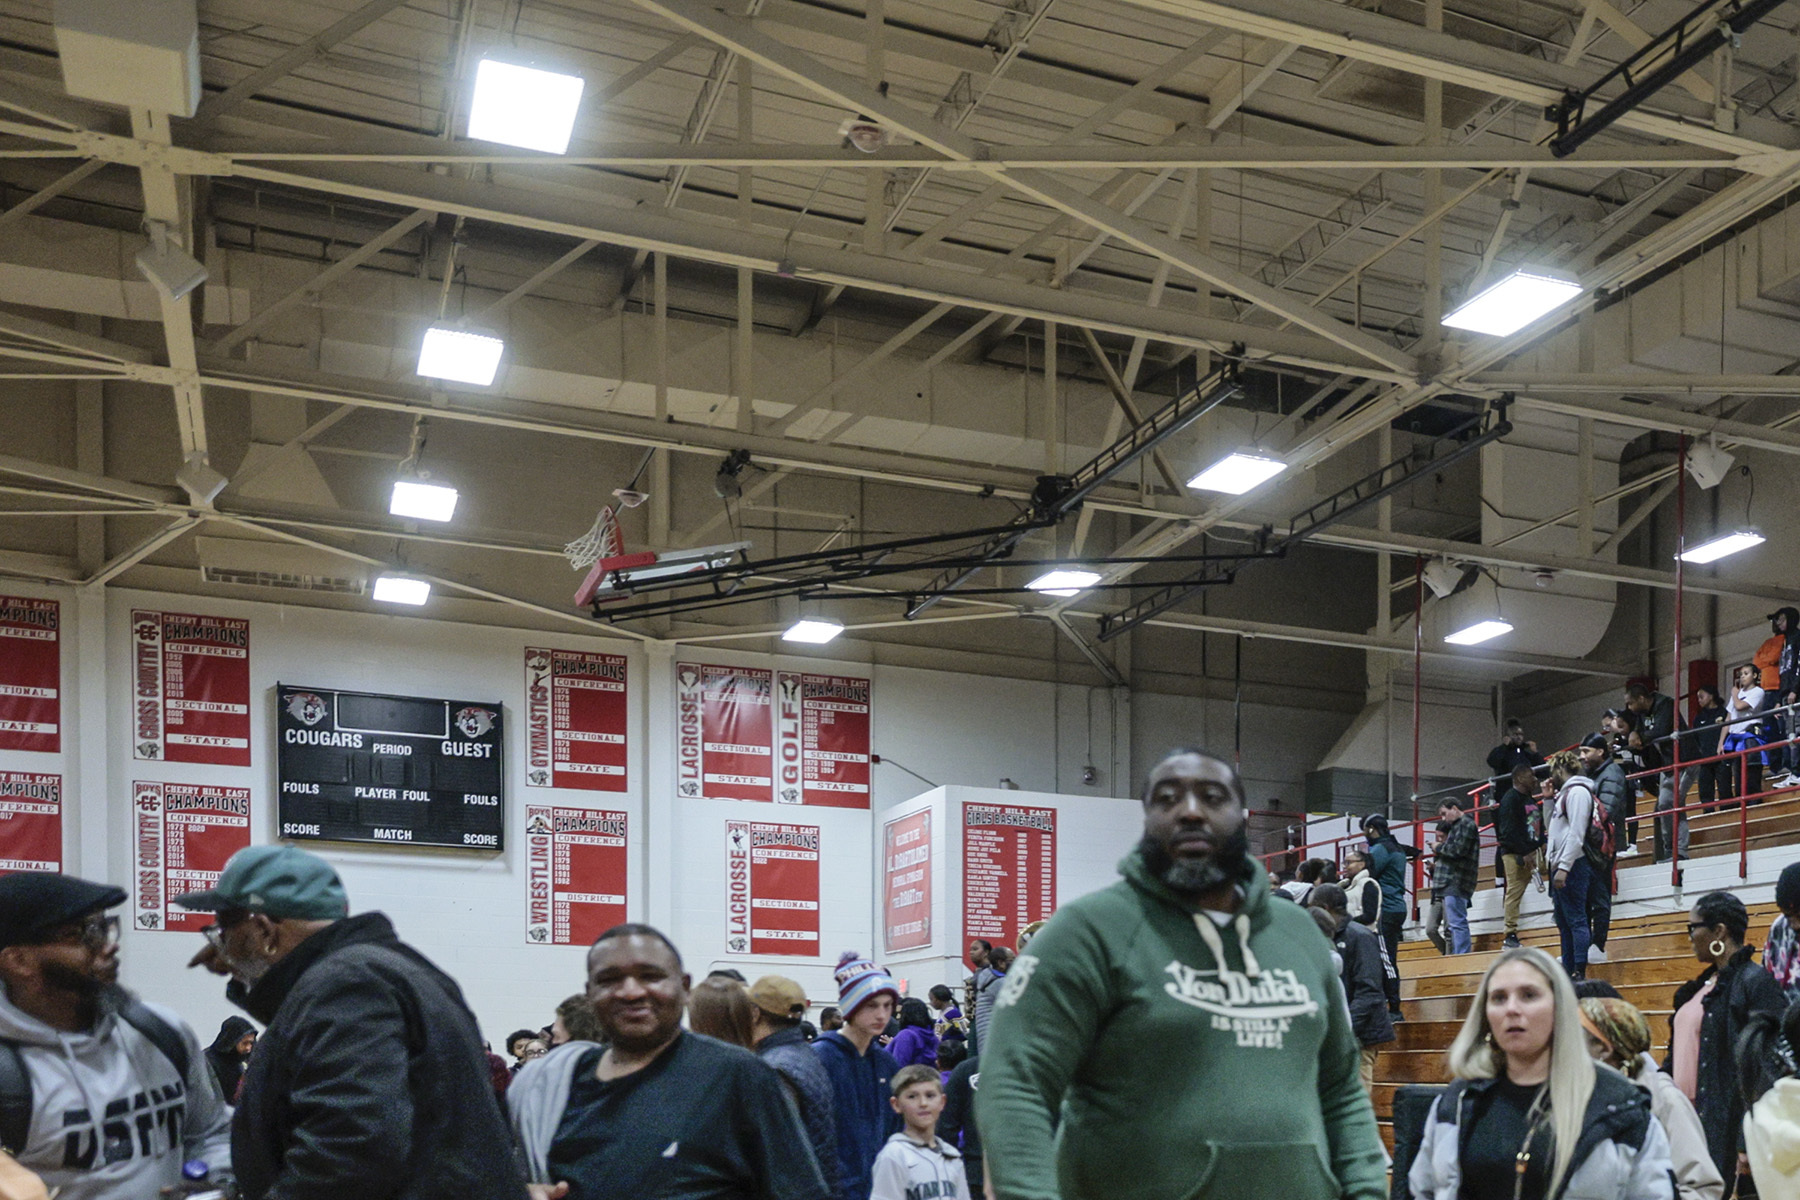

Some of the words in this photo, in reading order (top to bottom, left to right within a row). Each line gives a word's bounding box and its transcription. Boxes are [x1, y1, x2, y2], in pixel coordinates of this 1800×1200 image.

[34, 601, 57, 611] EAST
[225, 621, 247, 629] EAST
[165, 624, 246, 646] CHAMPIONS
[169, 644, 242, 657] CONFERENCE
[138, 642, 159, 697] COUNTRY
[554, 660, 625, 680] CHAMPIONS
[557, 678, 621, 690] CONFERENCE
[803, 683, 868, 703] CHAMPIONS
[175, 701, 238, 712] SECTIONAL
[806, 701, 864, 712] CONFERENCE
[138, 699, 160, 740] CROSS
[530, 685, 548, 767] GYMNASTICS
[184, 736, 231, 745] STATE
[286, 728, 363, 748] COUGARS
[562, 732, 616, 742] SECTIONAL
[681, 692, 698, 779] LACROSSE
[712, 744, 763, 753] SECTIONAL
[782, 702, 798, 784] GOLF
[373, 743, 412, 756] PERIOD
[441, 741, 493, 758] GUEST
[811, 751, 860, 761] SECTIONAL
[569, 764, 610, 773] STATE
[10, 774, 32, 783] HILL
[36, 775, 59, 784] EAST
[718, 776, 756, 784] STATE
[0, 782, 59, 802] MPIONS
[135, 783, 161, 796] BOYS
[165, 785, 199, 794] CHERRY
[202, 787, 222, 796] HILL
[226, 789, 248, 798] EAST
[283, 782, 320, 794] FOULS
[817, 782, 854, 790] STATE
[355, 787, 396, 799] PLAYER
[402, 790, 430, 801] FOUL
[464, 794, 498, 806] FOULS
[166, 794, 248, 816] CHAMPIONS
[967, 805, 1001, 813] CHERRY
[1005, 807, 1026, 815] HILL
[1030, 809, 1052, 817] EAST
[528, 808, 550, 818] BOYS
[554, 809, 583, 818] CHERRY
[586, 811, 603, 819] HILL
[606, 812, 626, 820] EAST
[170, 814, 244, 825] CONFERENCE
[967, 812, 992, 825] GIRLS
[994, 813, 1053, 832] BASKETBALL
[284, 823, 320, 835] SCORE
[555, 818, 625, 836] CHAMPIONS
[139, 812, 160, 867] COUNTRY
[374, 828, 412, 840] MATCH
[463, 834, 498, 845] SCORE
[558, 835, 622, 845] CONFERENCE
[752, 832, 818, 850] CHAMPIONS
[755, 850, 814, 859] CONFERENCE
[176, 870, 222, 879] SECTION
[531, 836, 548, 924] WRESTLING
[139, 870, 160, 910] CROSS
[731, 850, 746, 935] LACROSSE
[567, 893, 612, 902] DISTRICT
[760, 900, 810, 908] SECTIONAL
[1164, 960, 1231, 1006] Von
[1220, 969, 1310, 1005] Dutch
[1211, 1015, 1231, 1031] IS
[1232, 1018, 1276, 1032] STILL
